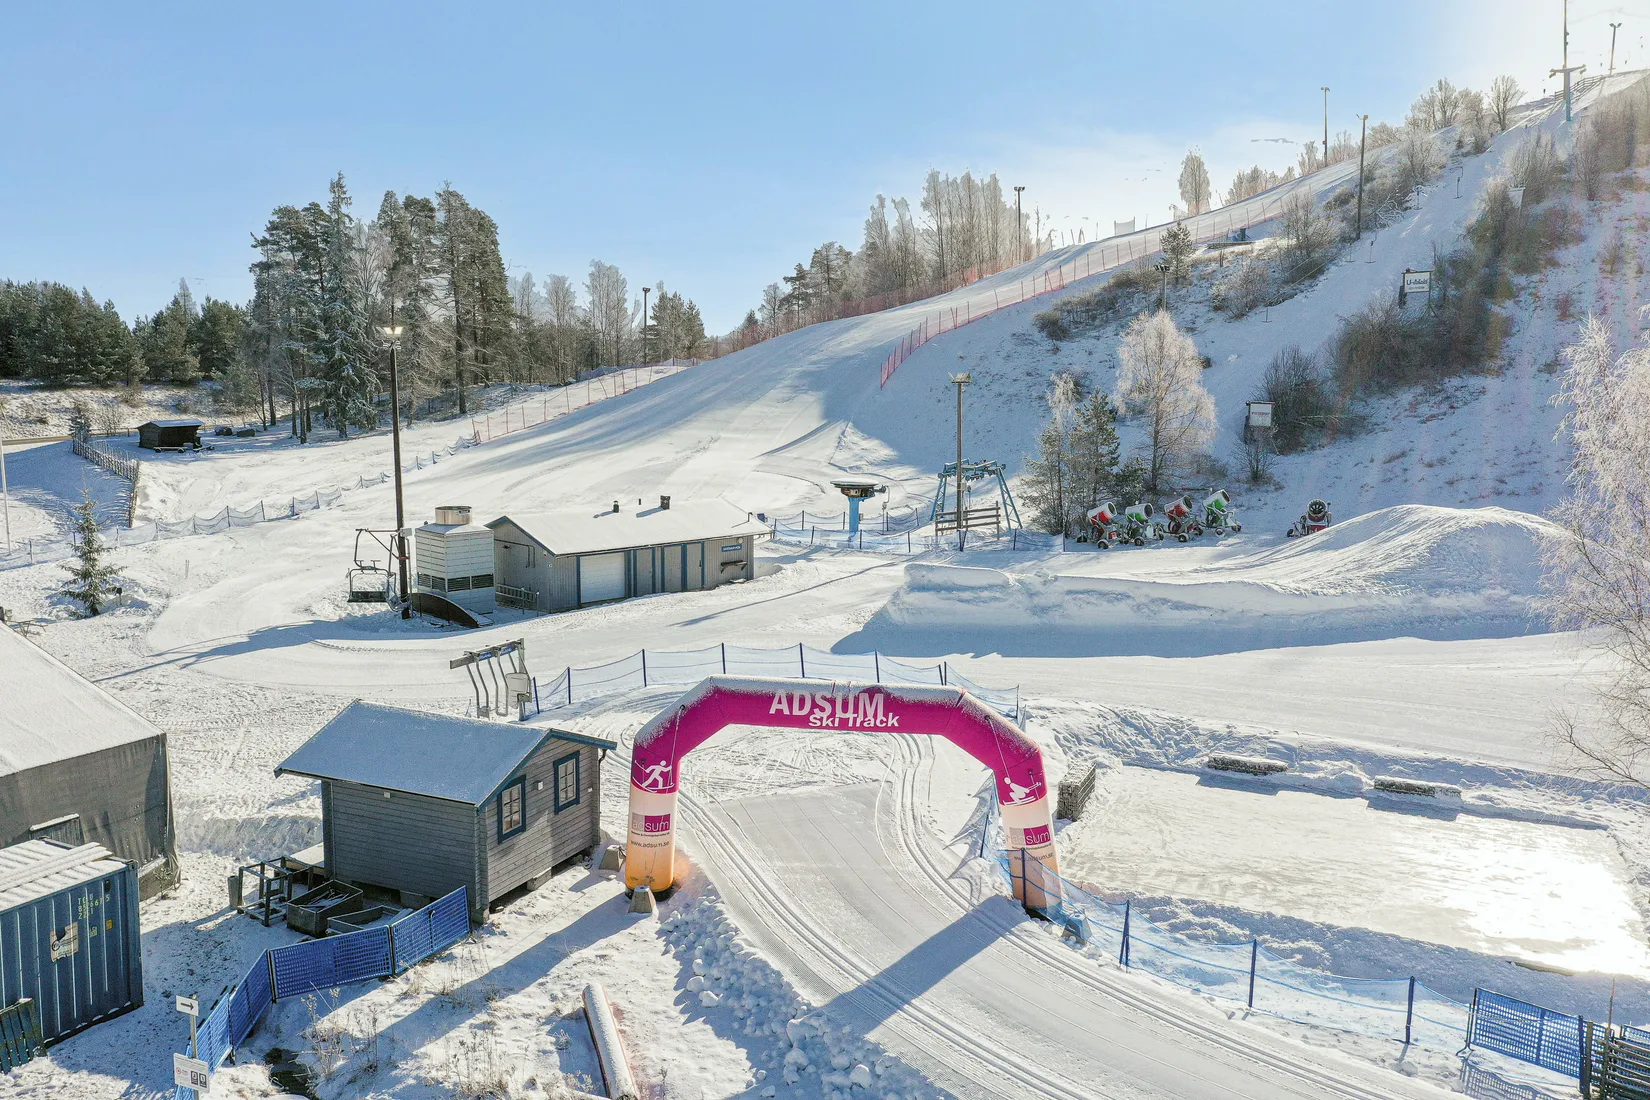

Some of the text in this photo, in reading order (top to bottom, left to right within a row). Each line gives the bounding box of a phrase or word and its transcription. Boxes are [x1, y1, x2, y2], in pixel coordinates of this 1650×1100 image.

[769, 690, 884, 720] ADSUM
[808, 713, 900, 727] Ski Track
[632, 819, 669, 832] adsum
